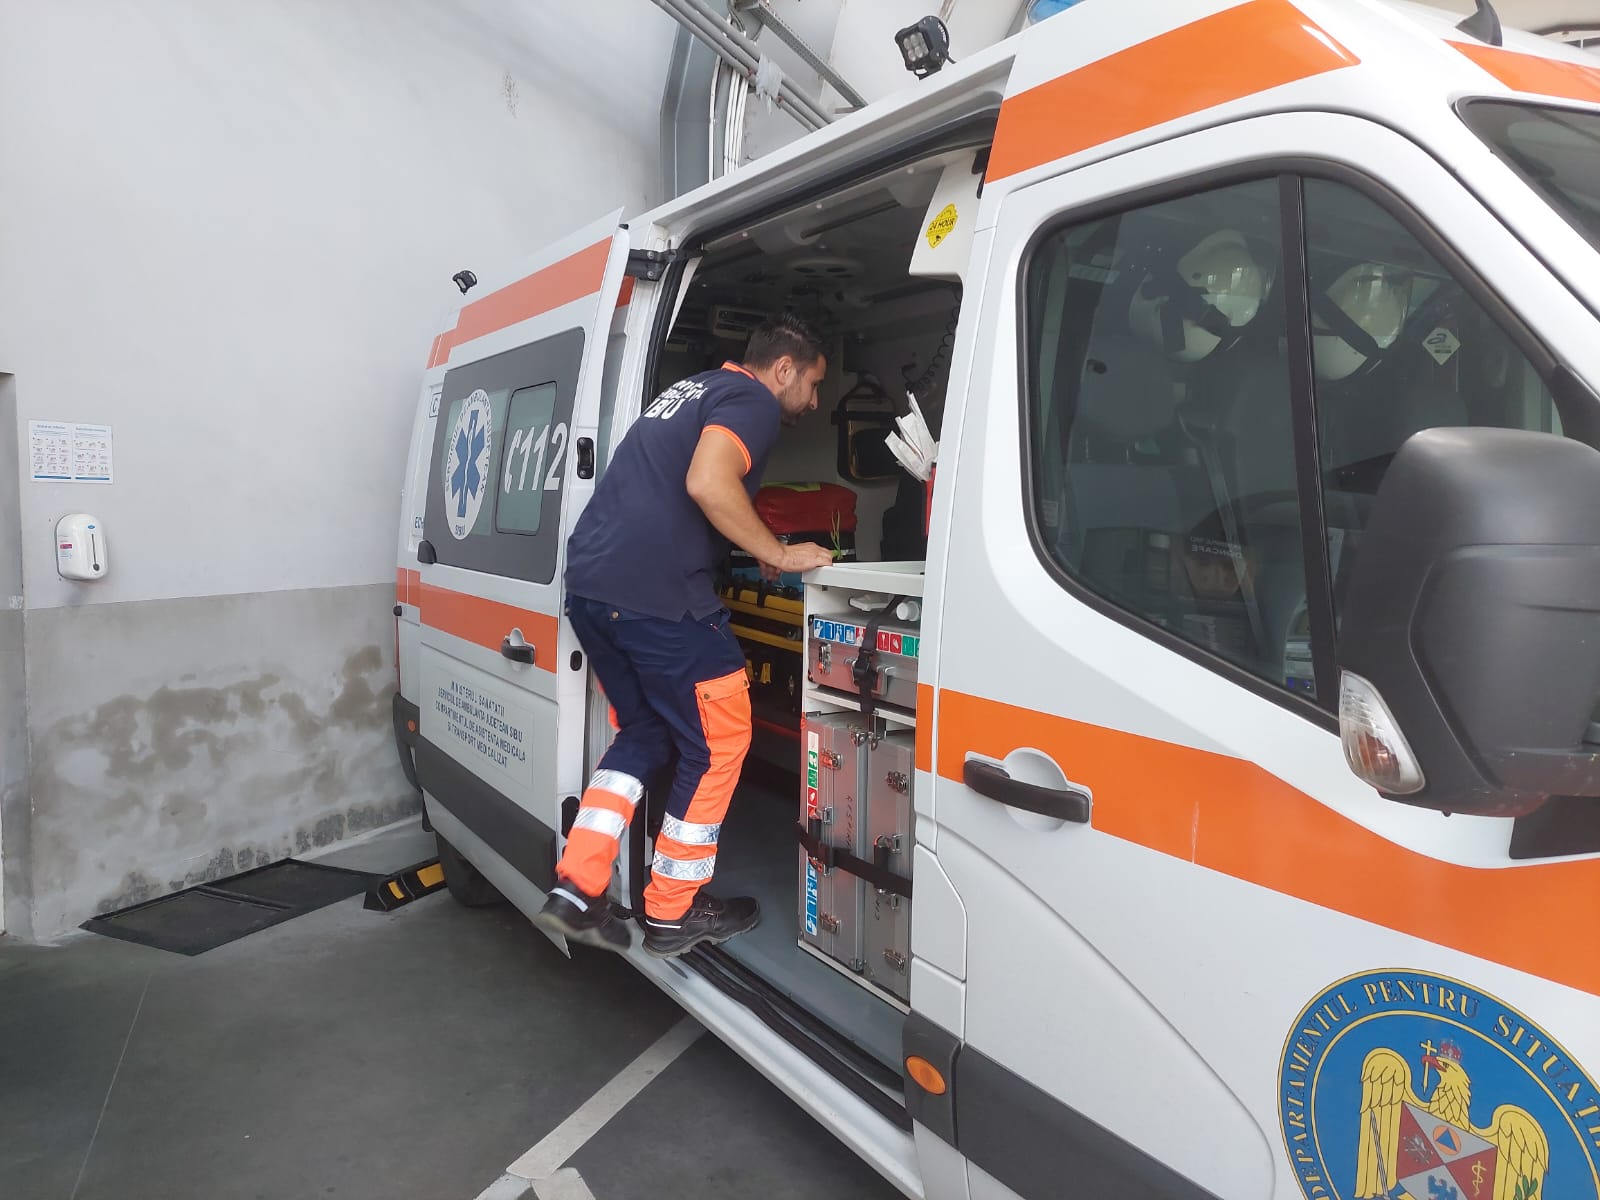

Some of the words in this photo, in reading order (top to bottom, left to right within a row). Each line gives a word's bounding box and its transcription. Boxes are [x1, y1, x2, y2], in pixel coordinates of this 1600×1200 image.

[518, 422, 568, 491] 112
[510, 726, 522, 744] SIBIU
[1363, 979, 1480, 1018] PENTRU
